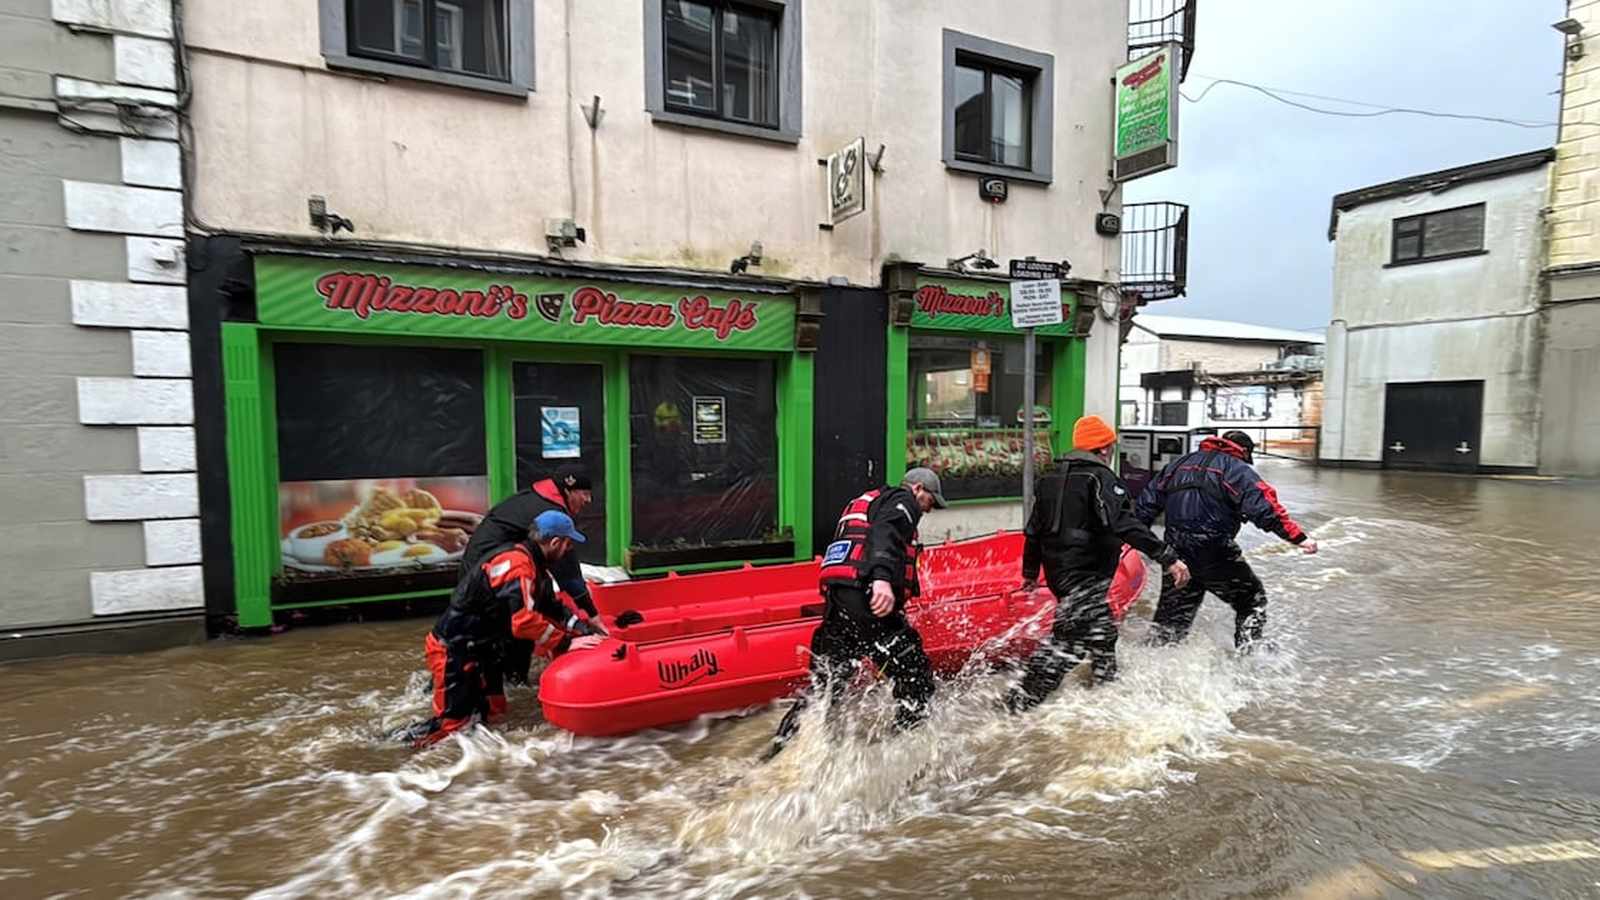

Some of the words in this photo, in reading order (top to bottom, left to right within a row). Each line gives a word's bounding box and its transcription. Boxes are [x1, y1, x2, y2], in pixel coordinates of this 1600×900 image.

[316, 271, 529, 320] Mizzoni's
[572, 286, 675, 328] Pizza
[678, 296, 758, 340] Café
[915, 284, 1004, 318] Mizzoni's
[656, 648, 720, 684] Whaly
